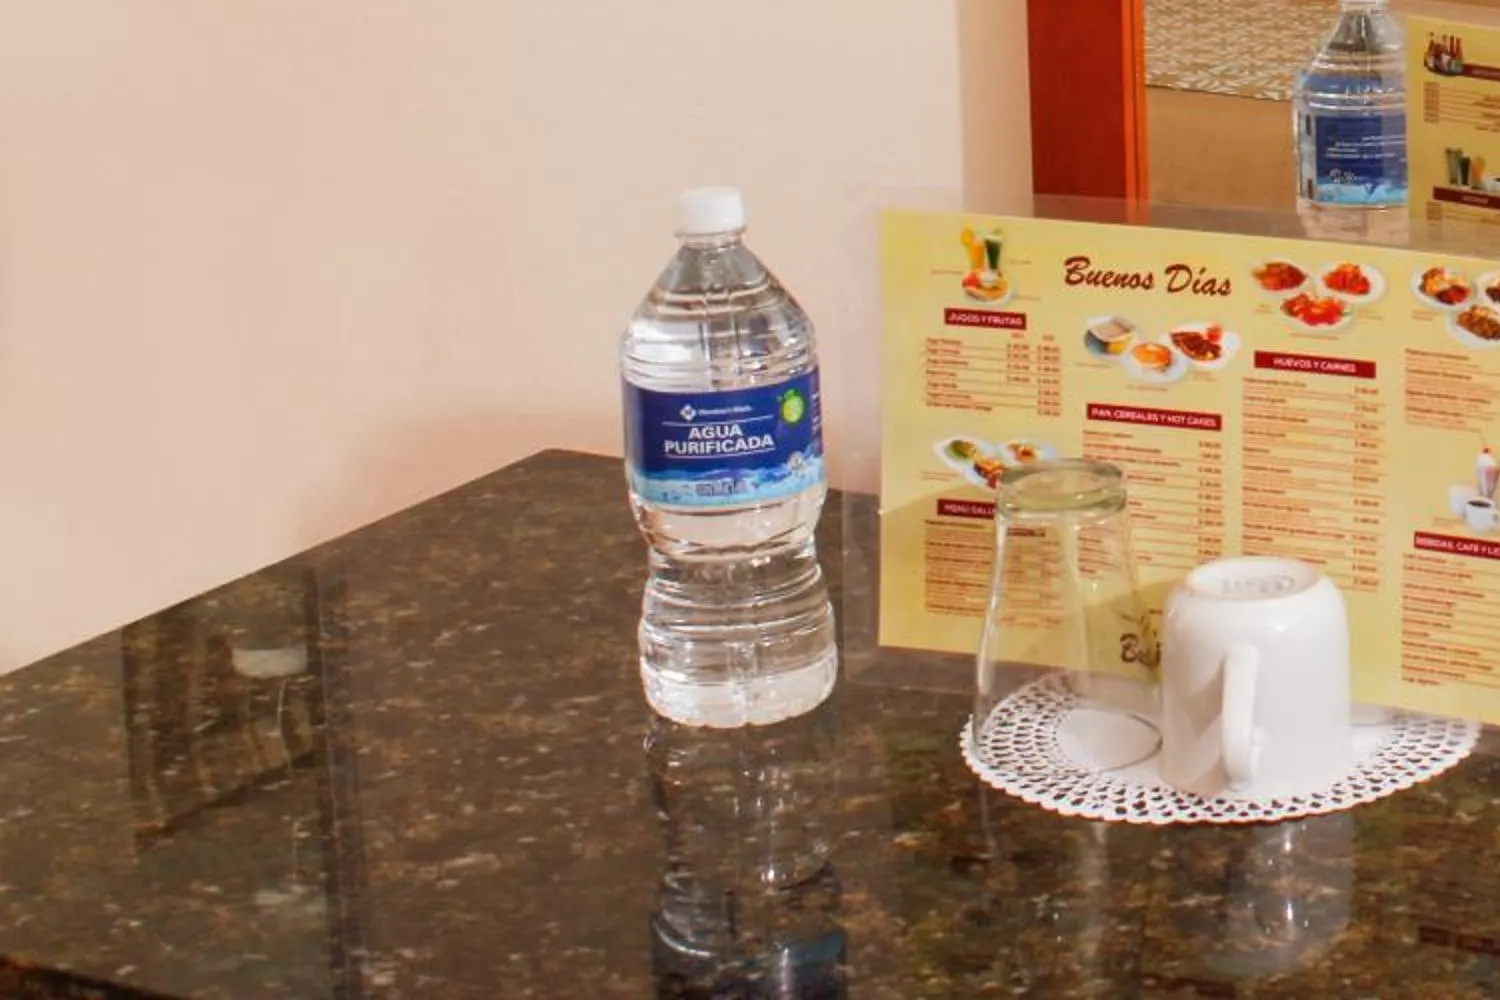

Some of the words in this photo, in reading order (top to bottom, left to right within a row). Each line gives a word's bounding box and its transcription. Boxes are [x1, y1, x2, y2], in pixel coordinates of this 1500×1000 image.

[1063, 255, 1154, 290] Buenos
[1165, 263, 1231, 296] Días
[948, 312, 980, 323] JUGOS
[988, 314, 1023, 326] FRUTAS
[1273, 357, 1312, 369] HUEVOS
[1320, 361, 1357, 373] CARNES
[1113, 408, 1159, 421] CEREALES
[1167, 414, 1186, 424] HOT
[688, 424, 744, 439] AGUA
[664, 433, 775, 454] PURIFICADA
